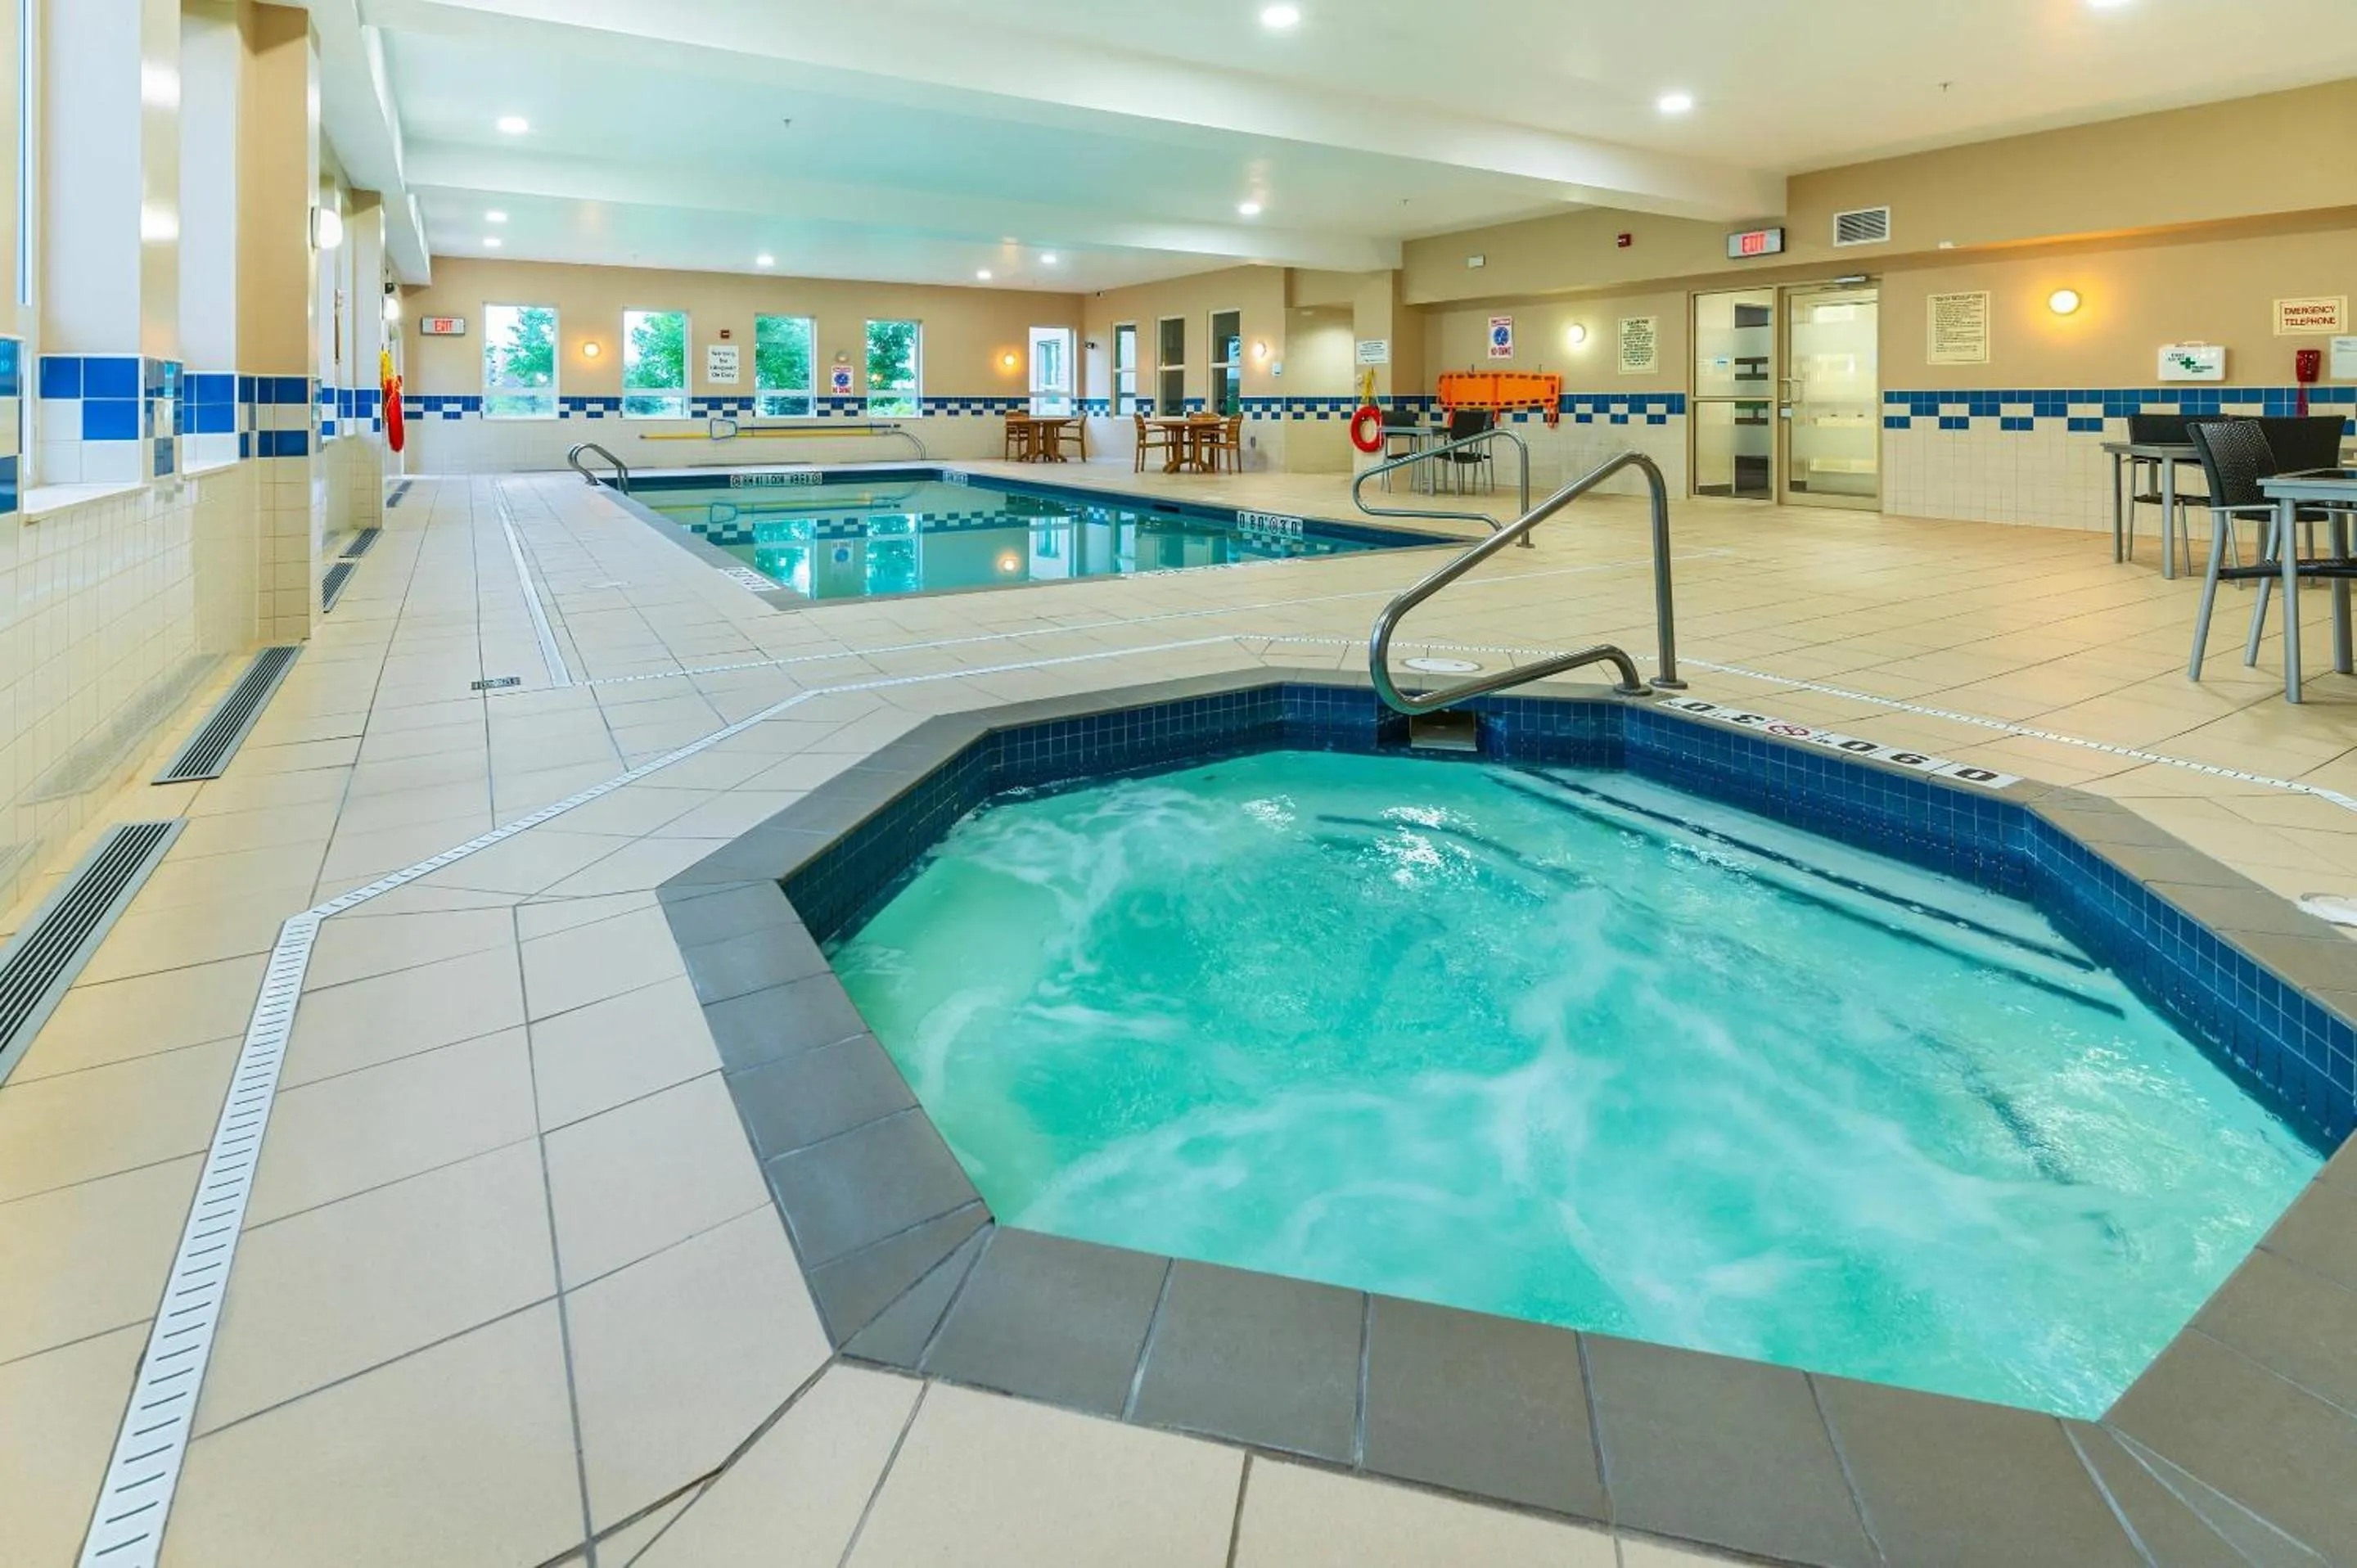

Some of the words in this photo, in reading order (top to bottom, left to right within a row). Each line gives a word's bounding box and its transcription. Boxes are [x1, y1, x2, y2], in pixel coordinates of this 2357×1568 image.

[1742, 233, 1764, 254] EXIT
[2284, 305, 2336, 315] EMERGENCY
[435, 320, 453, 331] EXIT
[2284, 317, 2336, 327] TELEPHONE
